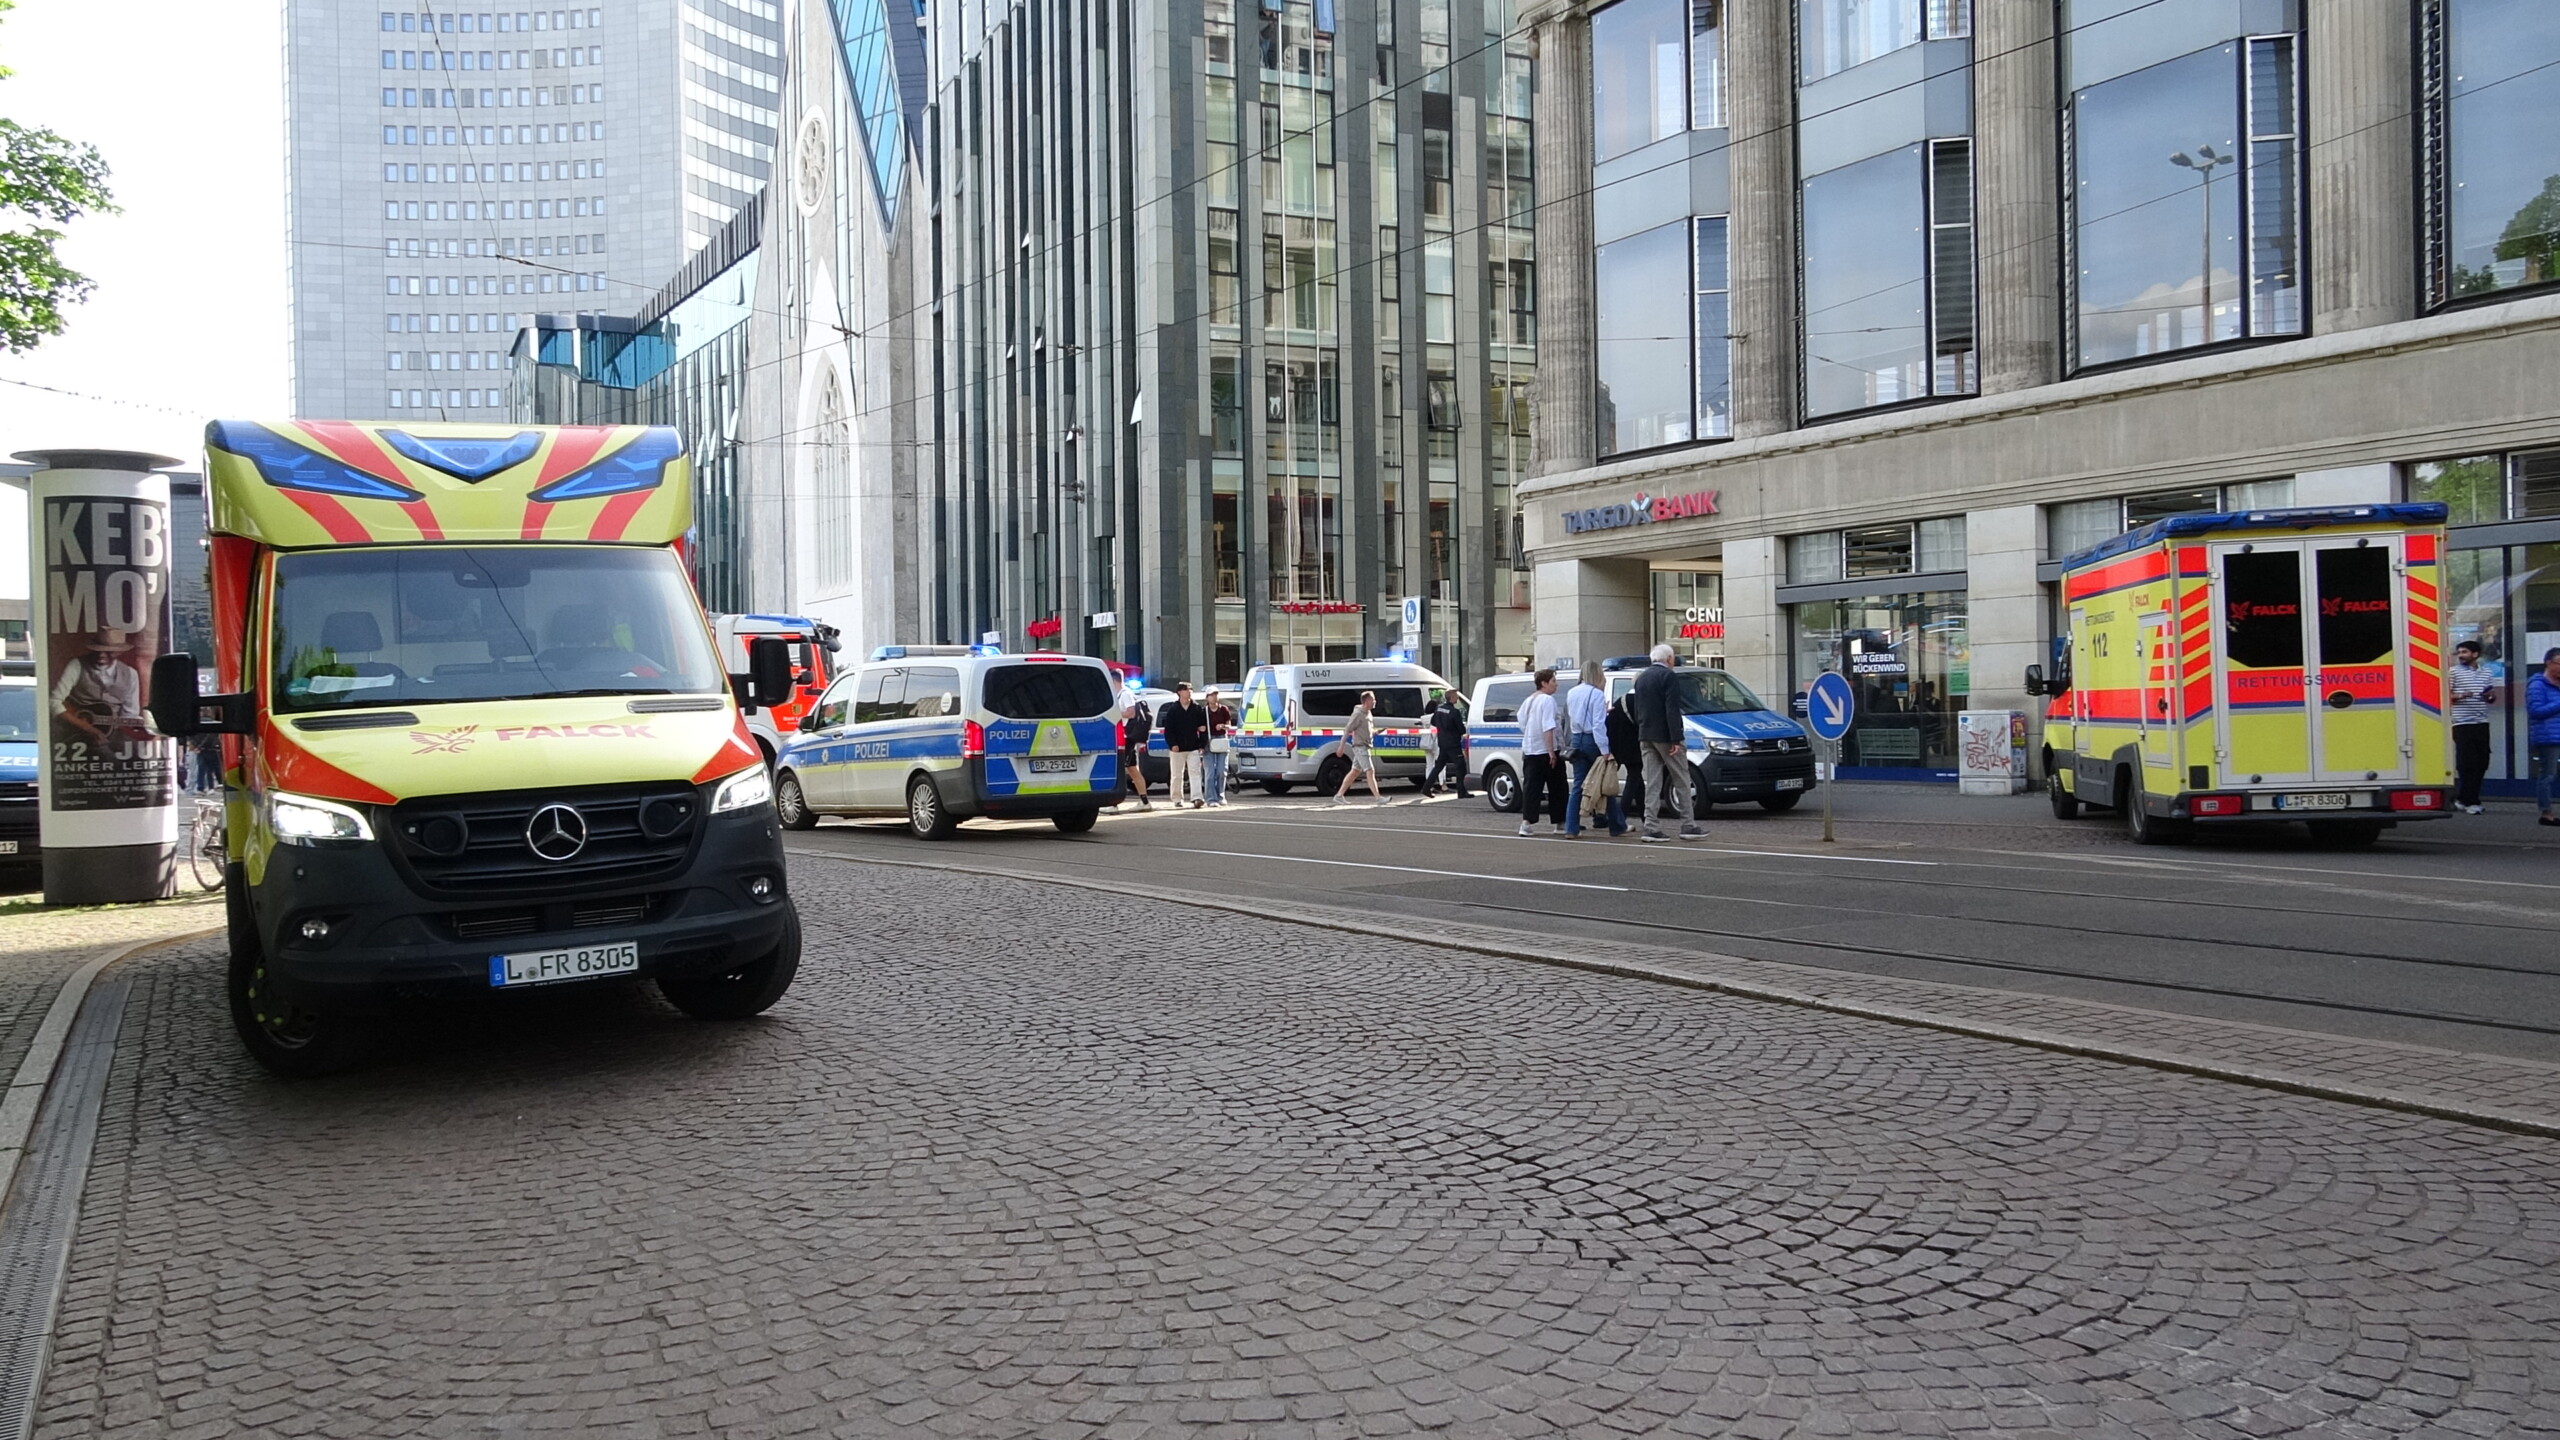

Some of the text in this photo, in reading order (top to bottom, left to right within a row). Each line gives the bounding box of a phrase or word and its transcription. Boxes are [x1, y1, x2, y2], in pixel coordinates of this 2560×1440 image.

[2252, 604, 2297, 616] FALCK
[2344, 601, 2389, 612] FALCK
[1686, 607, 1722, 622] CENT
[2093, 632, 2107, 658] 112
[1853, 654, 1895, 663] WIR GEBEN
[1312, 669, 1330, 677] 10-07
[1853, 663, 1906, 673] RÜCKENWIND
[2237, 672, 2386, 688] RETTUNGSWAGEN
[1744, 721, 1793, 731] POLIZEI
[496, 725, 657, 741] FALCK
[989, 730, 1030, 740] POLIZEI
[1383, 736, 1419, 747] POLIZEI
[54, 742, 99, 761] 22.
[854, 743, 890, 759] POLIZEI
[54, 762, 114, 772] ANKER
[1035, 761, 1046, 770] BP
[2286, 796, 2292, 806] L
[2300, 795, 2314, 806] FR
[507, 946, 635, 980] L FR 8305
